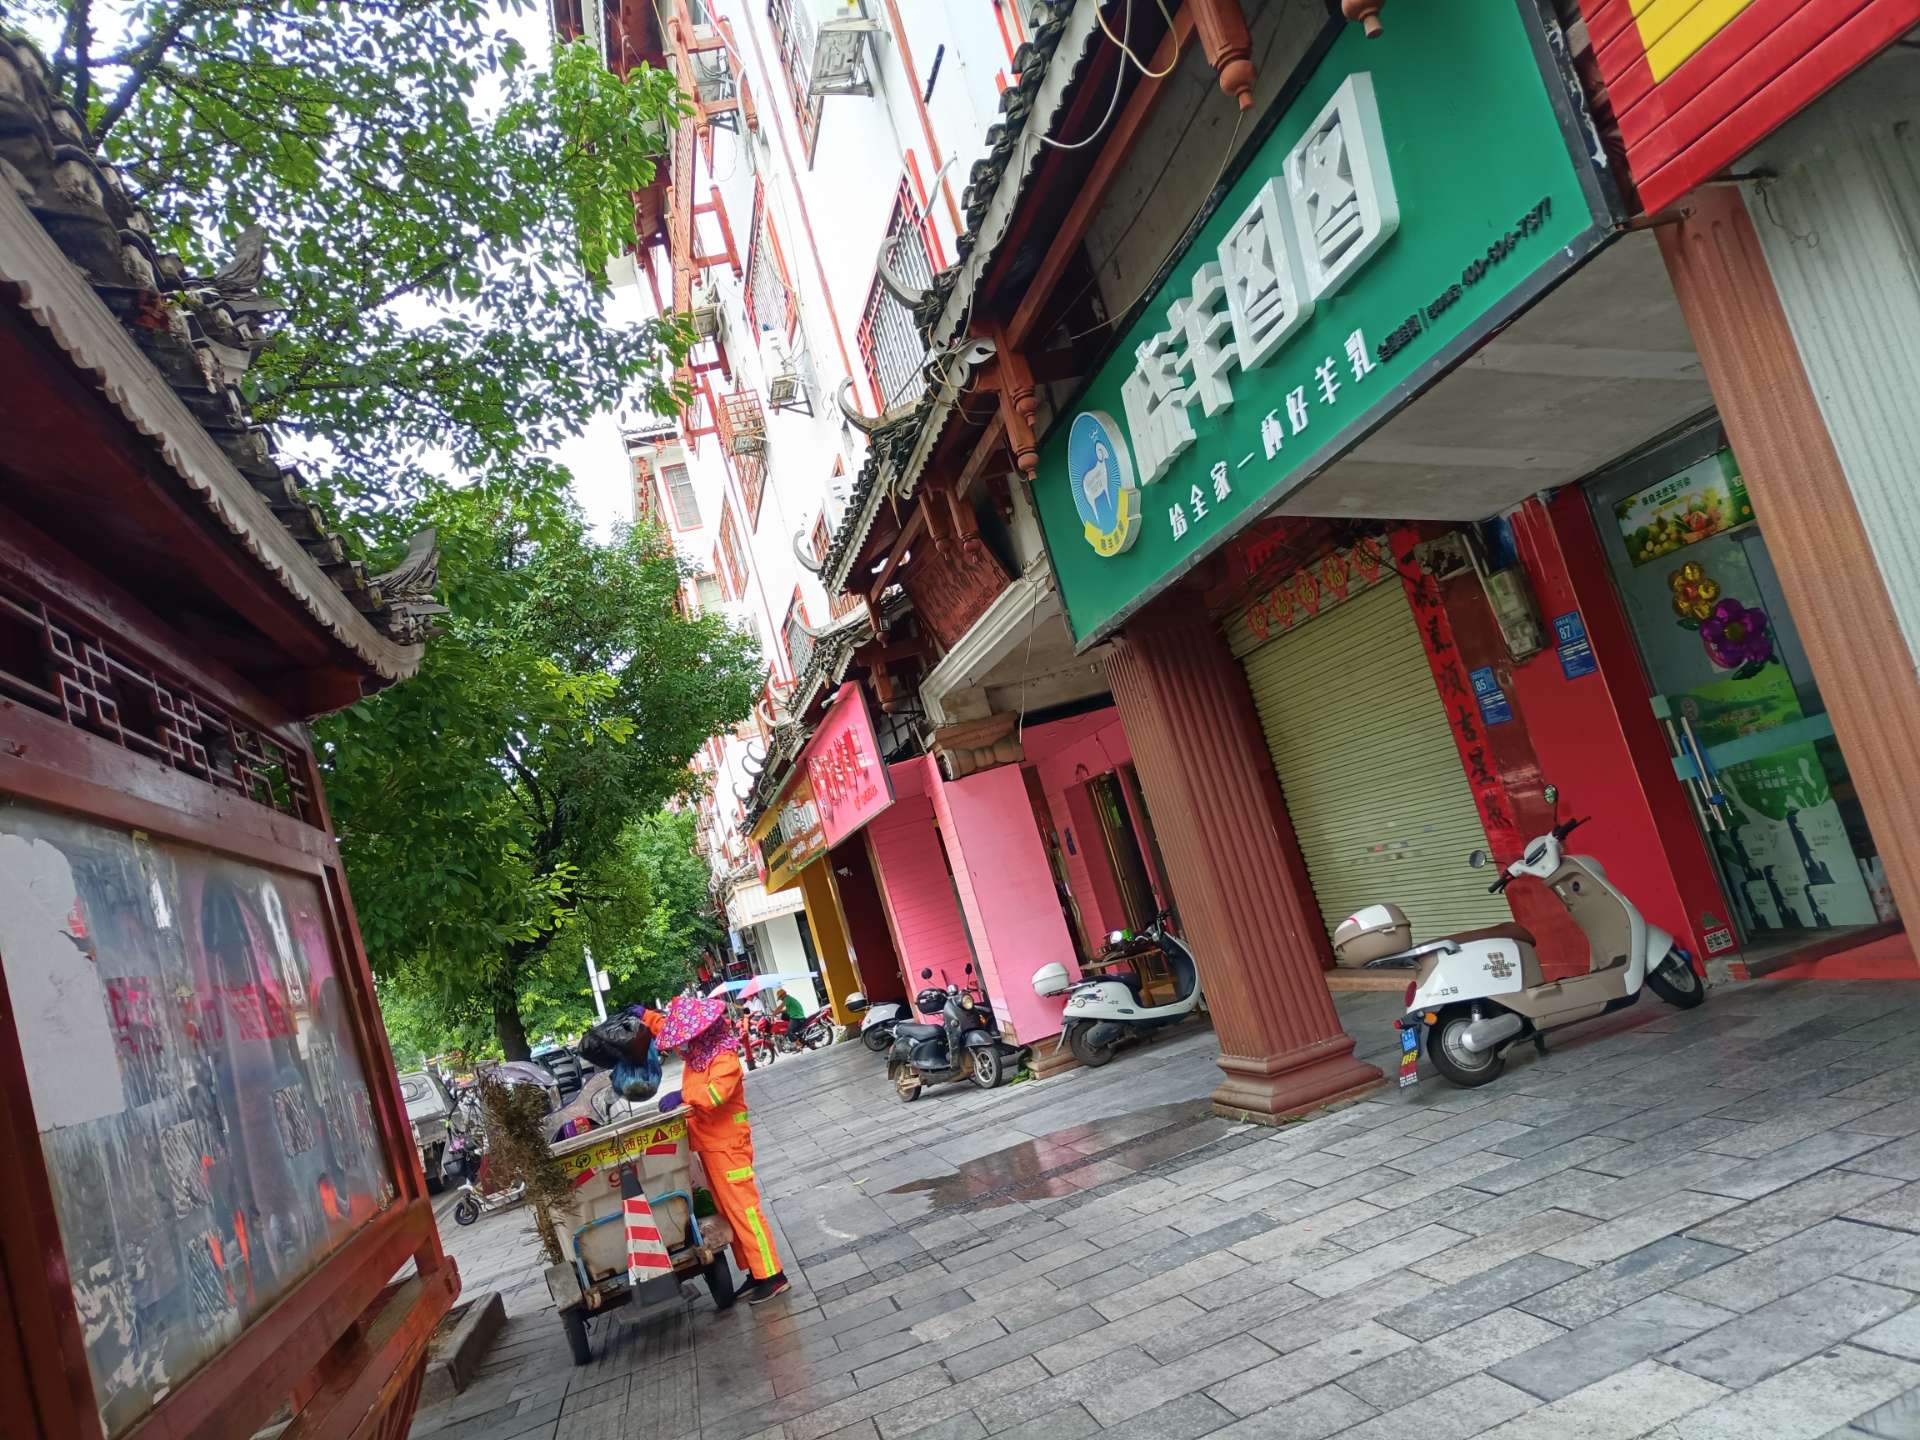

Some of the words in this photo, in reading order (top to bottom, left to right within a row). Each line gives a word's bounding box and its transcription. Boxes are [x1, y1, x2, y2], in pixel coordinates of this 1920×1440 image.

[1169, 328, 1377, 542] 给全家一杯好羊乳
[1559, 625, 1571, 640] 87
[1475, 679, 1487, 692] 85
